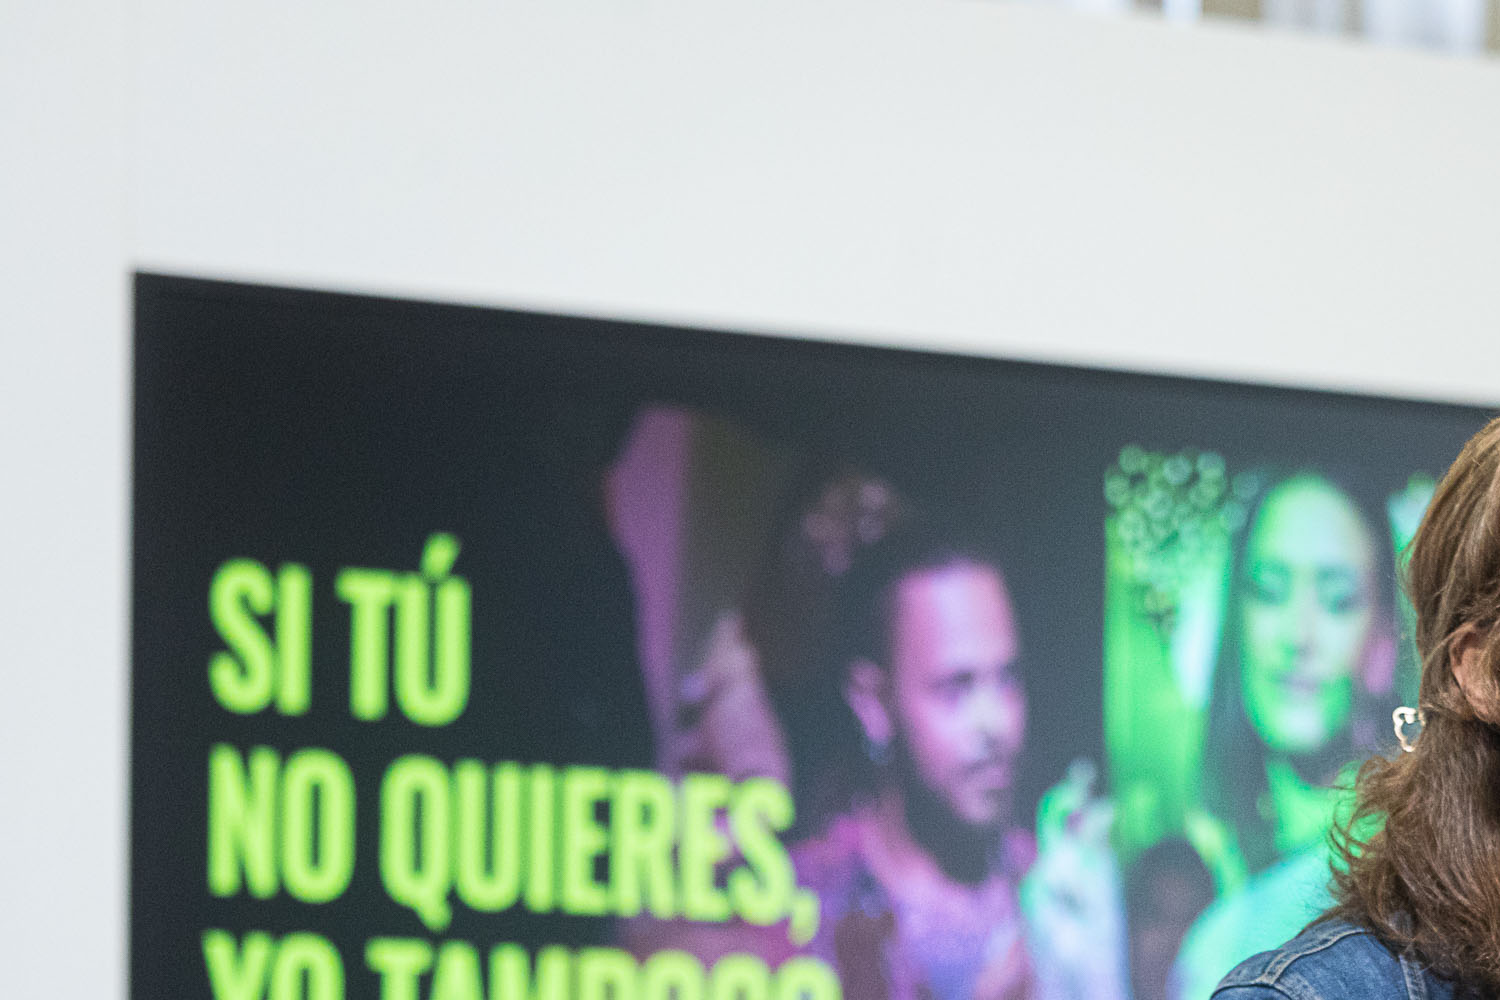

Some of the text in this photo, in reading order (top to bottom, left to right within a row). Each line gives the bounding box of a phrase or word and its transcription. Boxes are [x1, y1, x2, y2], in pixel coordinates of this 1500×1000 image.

[208, 531, 473, 727] SI TÚ
[207, 743, 821, 946] NO QUIERES,
